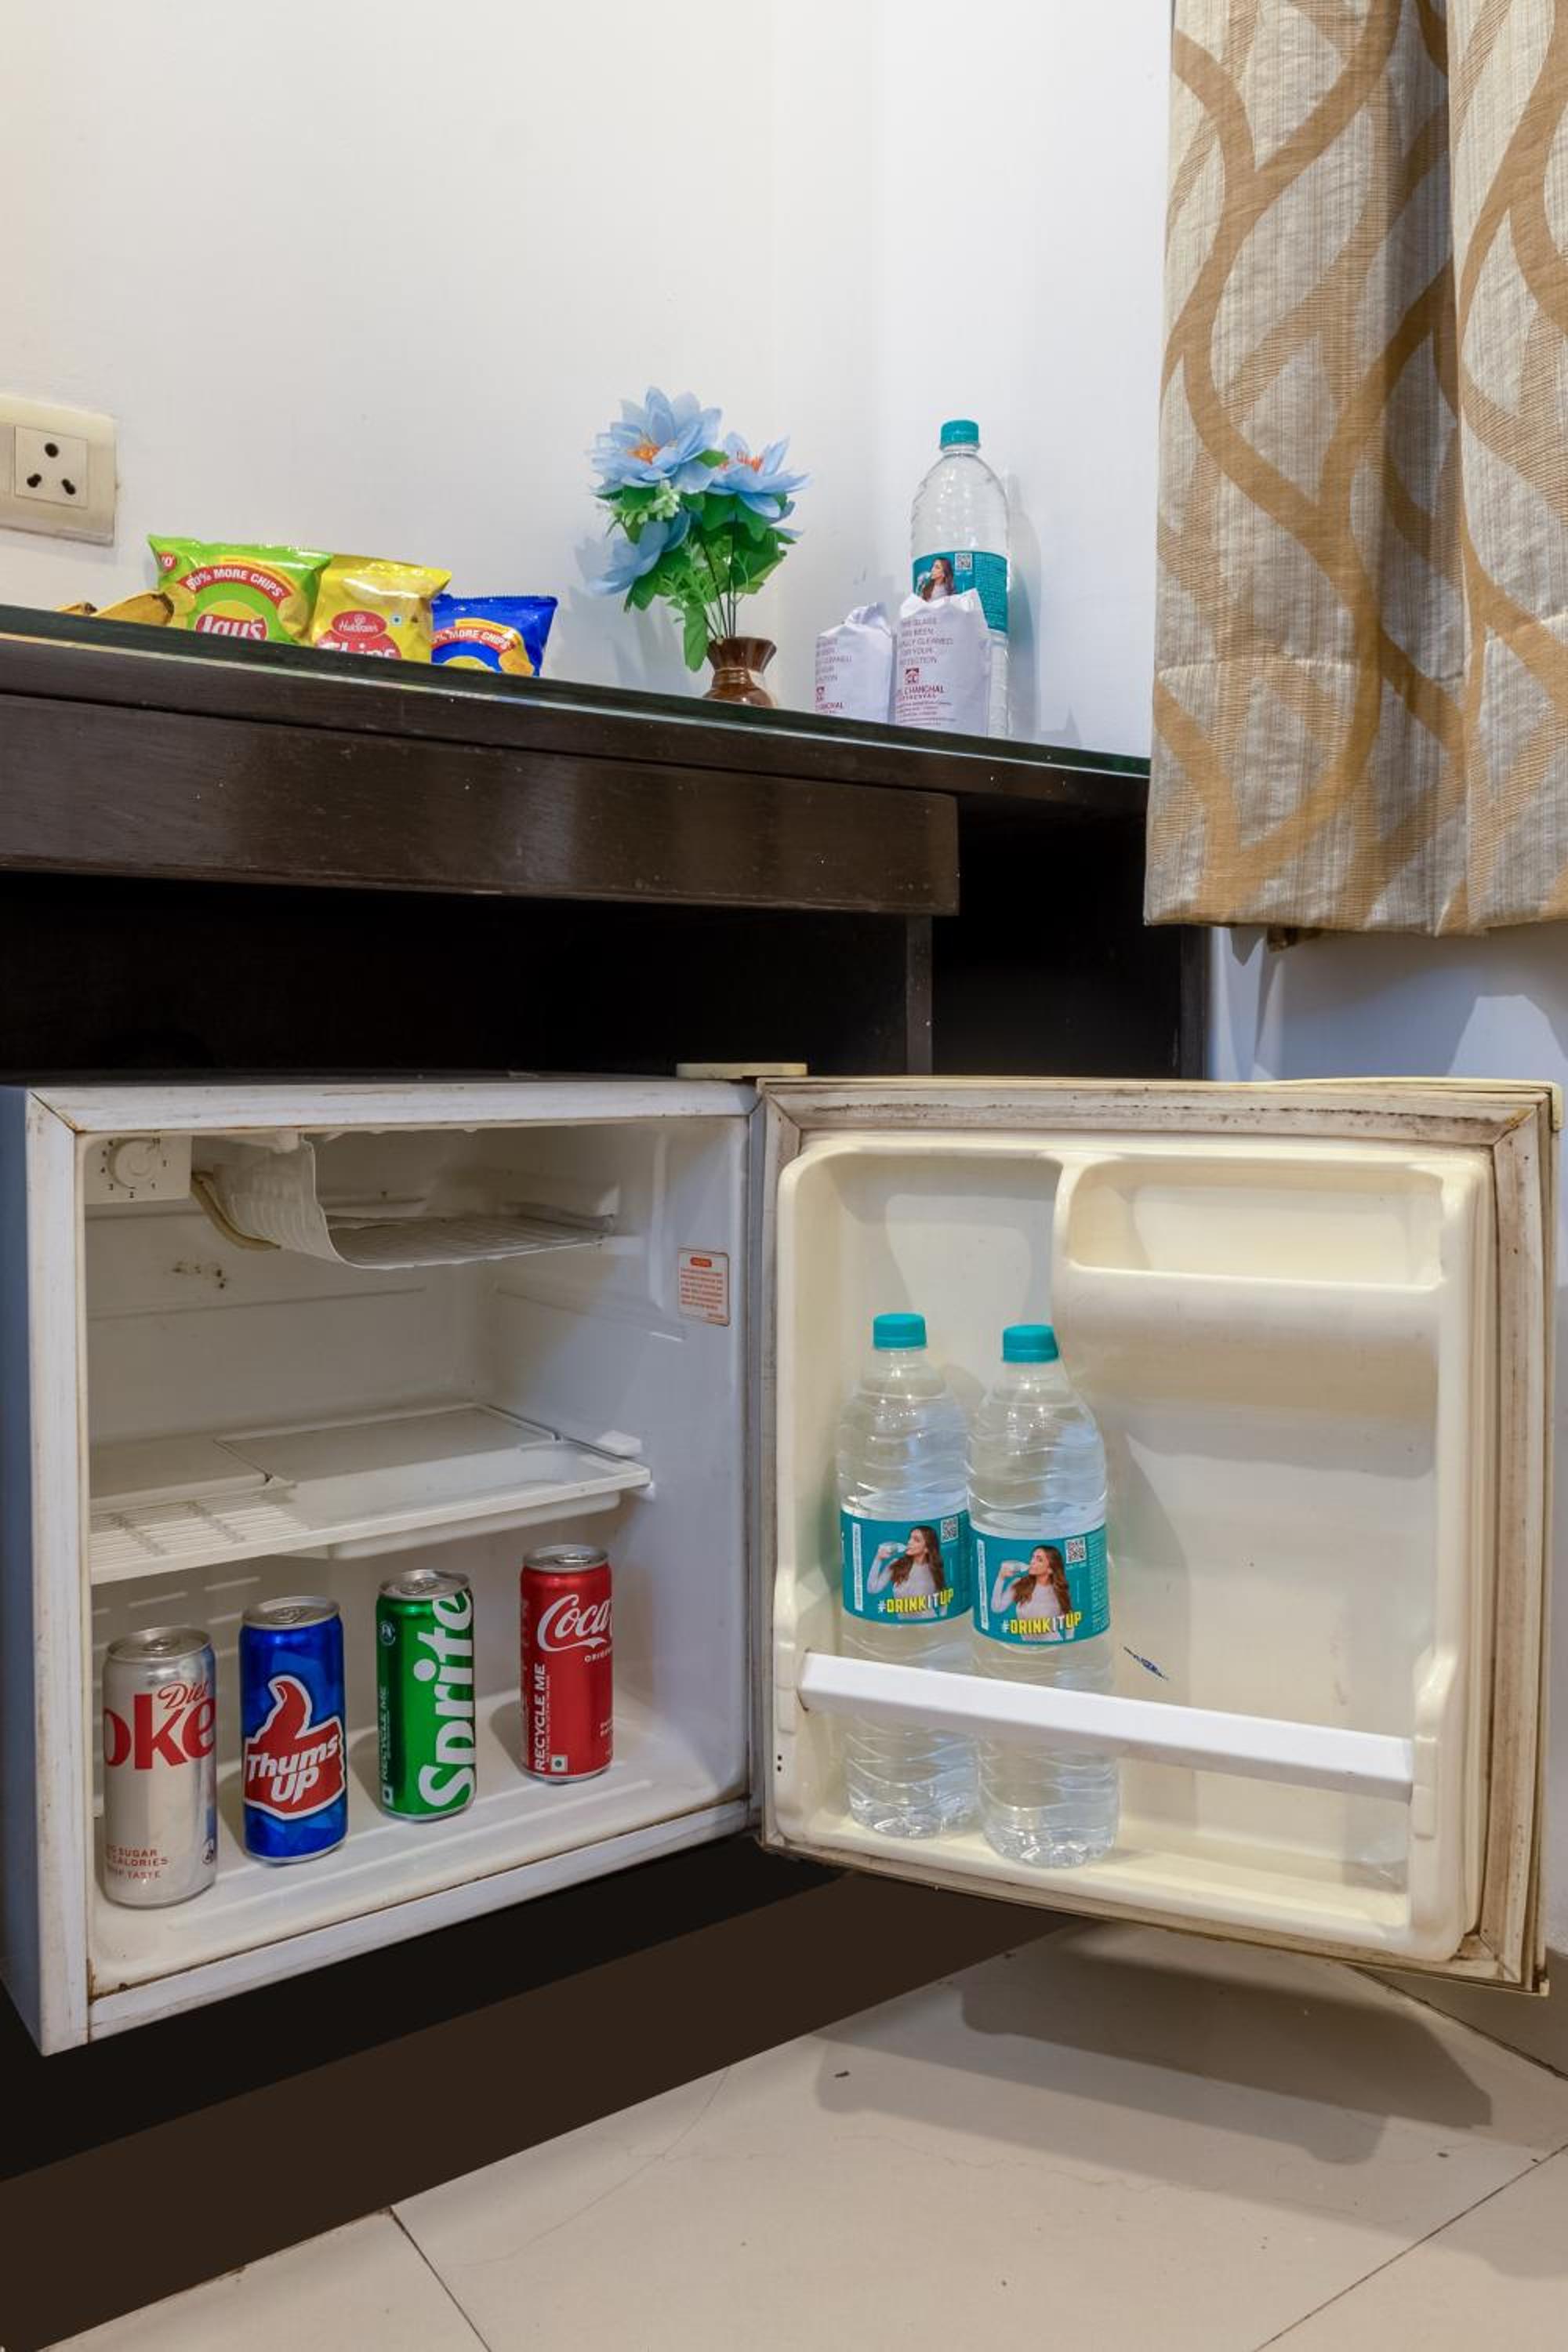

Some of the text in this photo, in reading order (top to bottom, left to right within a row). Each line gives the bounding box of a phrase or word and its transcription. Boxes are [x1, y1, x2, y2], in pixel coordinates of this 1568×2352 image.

[213, 568, 249, 579] MORE
[250, 573, 283, 597] CHIPS
[878, 1588, 954, 1613] #DRINKITUP
[1001, 1611, 1082, 1635] #DRINKITUP
[412, 1591, 477, 1807] Sprite
[534, 1662, 546, 1772] RECYCLE ME
[247, 1733, 339, 1782] Thums
[270, 1766, 320, 1806] UP
[118, 1846, 158, 1858] SUGAR
